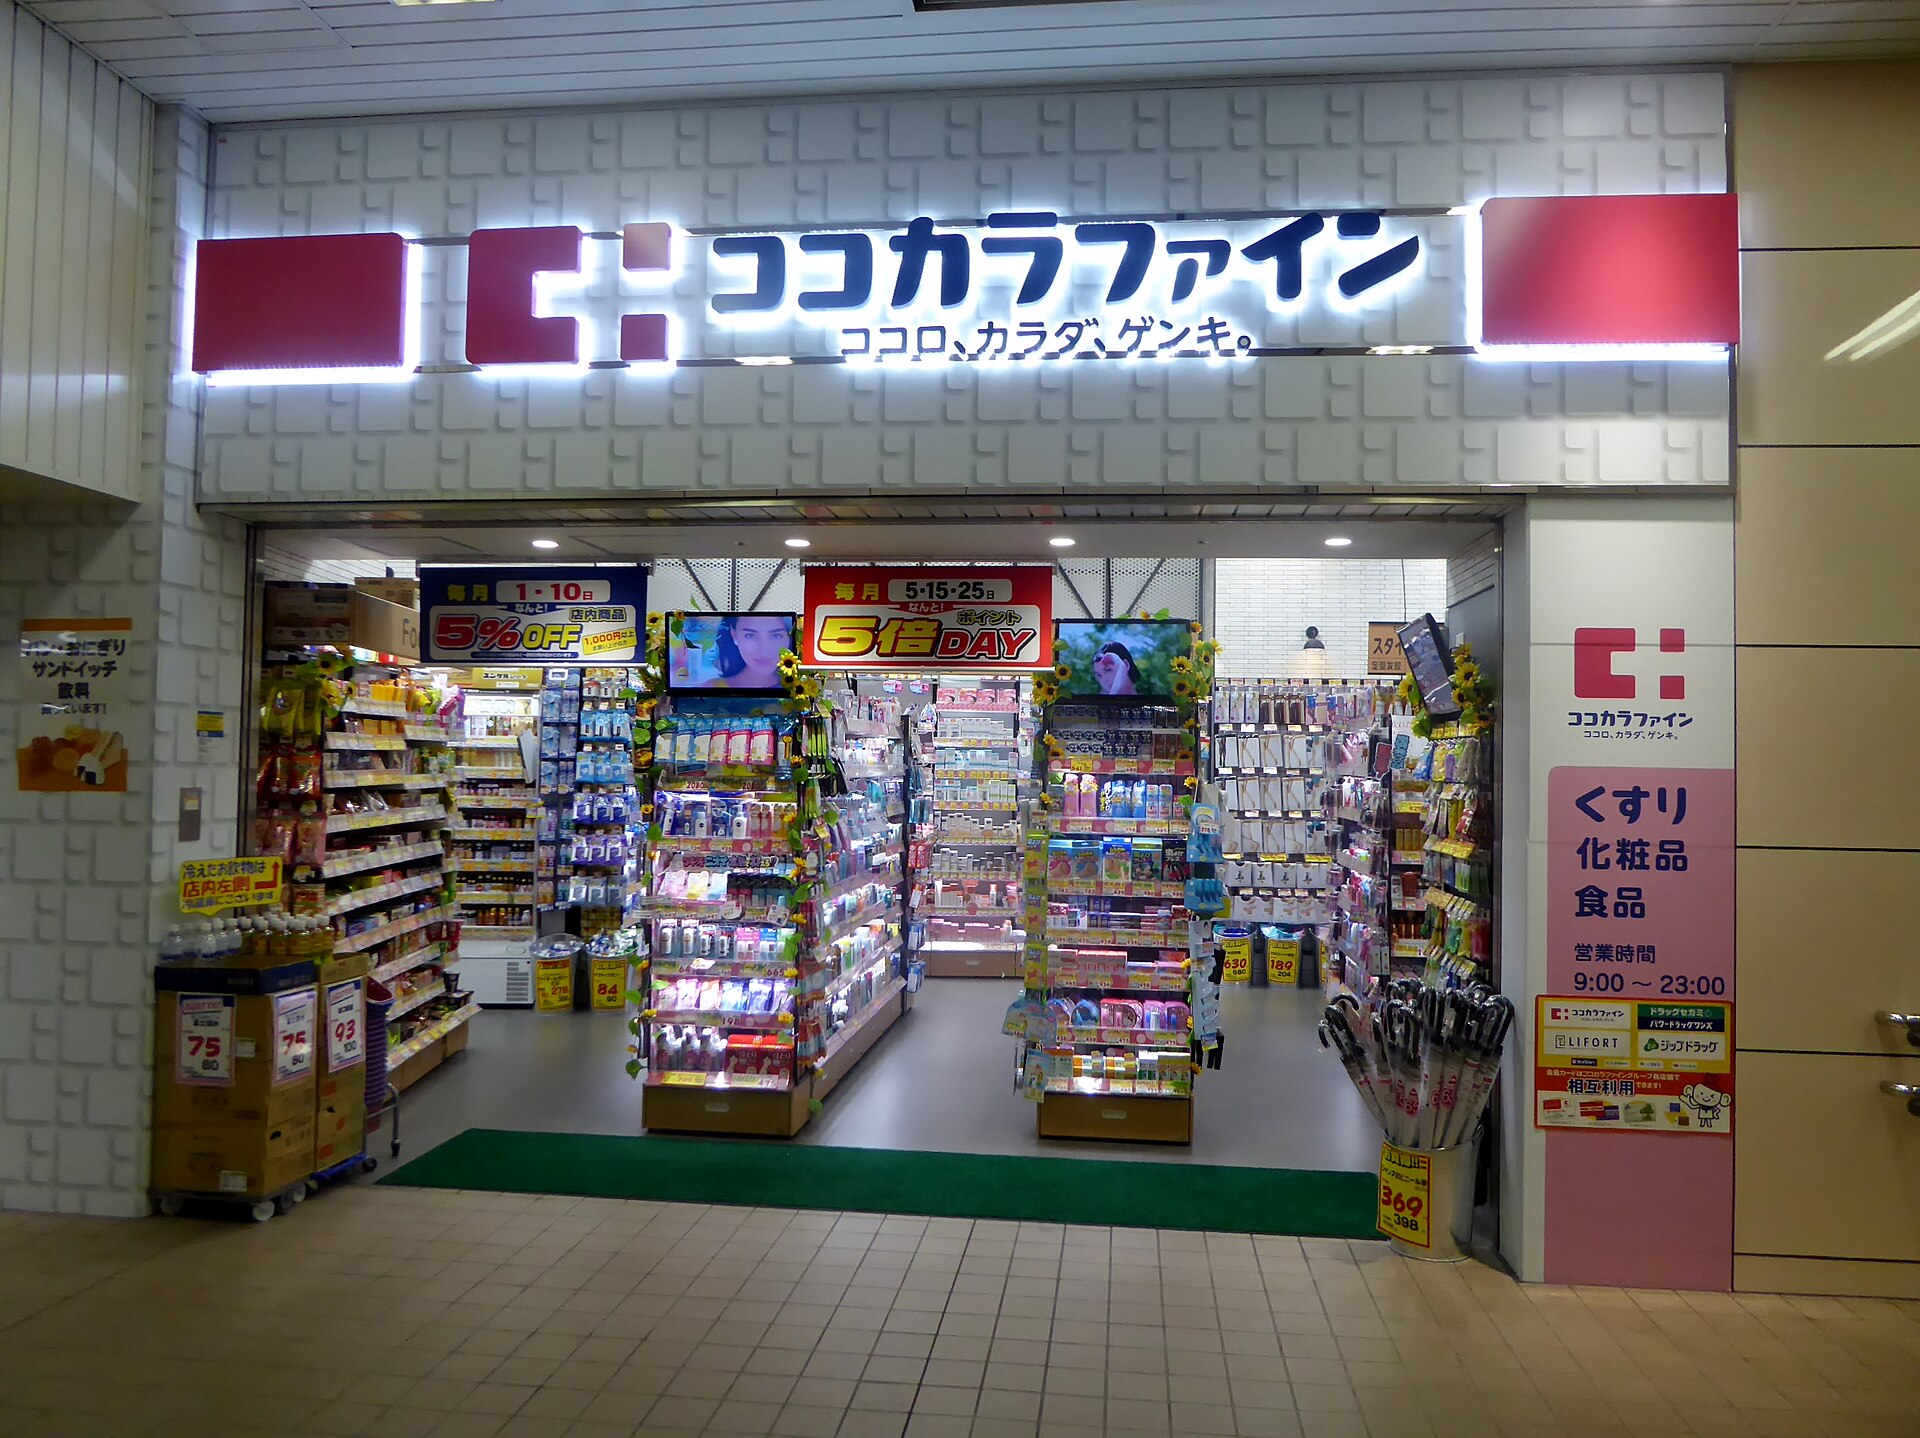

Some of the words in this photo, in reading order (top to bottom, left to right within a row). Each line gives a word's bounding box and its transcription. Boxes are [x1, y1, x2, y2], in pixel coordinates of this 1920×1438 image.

[711, 212, 1419, 312] ココカラファイン
[841, 316, 1252, 356] ココロ、カラダ、ゲンキ。
[570, 608, 625, 621] 店内商品
[957, 610, 1022, 625] ポイント
[33, 660, 118, 678] サンドイッチ
[1568, 710, 1693, 728] ココカラファイン
[1583, 730, 1679, 741] ココロ、カラダ、ゲンキ。
[1575, 785, 1687, 825] くすり
[1576, 837, 1689, 872] 化粧品
[1574, 884, 1646, 919] 食品
[1574, 943, 1656, 964] 営業時間
[1225, 958, 1247, 969] 630
[1271, 959, 1293, 970] 189
[598, 984, 618, 995] 84
[1574, 972, 1624, 993] 9:00
[1660, 975, 1725, 996] 23:00
[1572, 1009, 1624, 1017] ココカラファイン
[336, 1019, 356, 1042] 93
[188, 1035, 221, 1057] 75
[1569, 1037, 1618, 1048] LIFORT
[1661, 1040, 1718, 1053] ジップドラッグ
[1568, 1078, 1635, 1096] 相互利用
[1382, 1185, 1423, 1217] 369
[1394, 1214, 1418, 1231] 398
